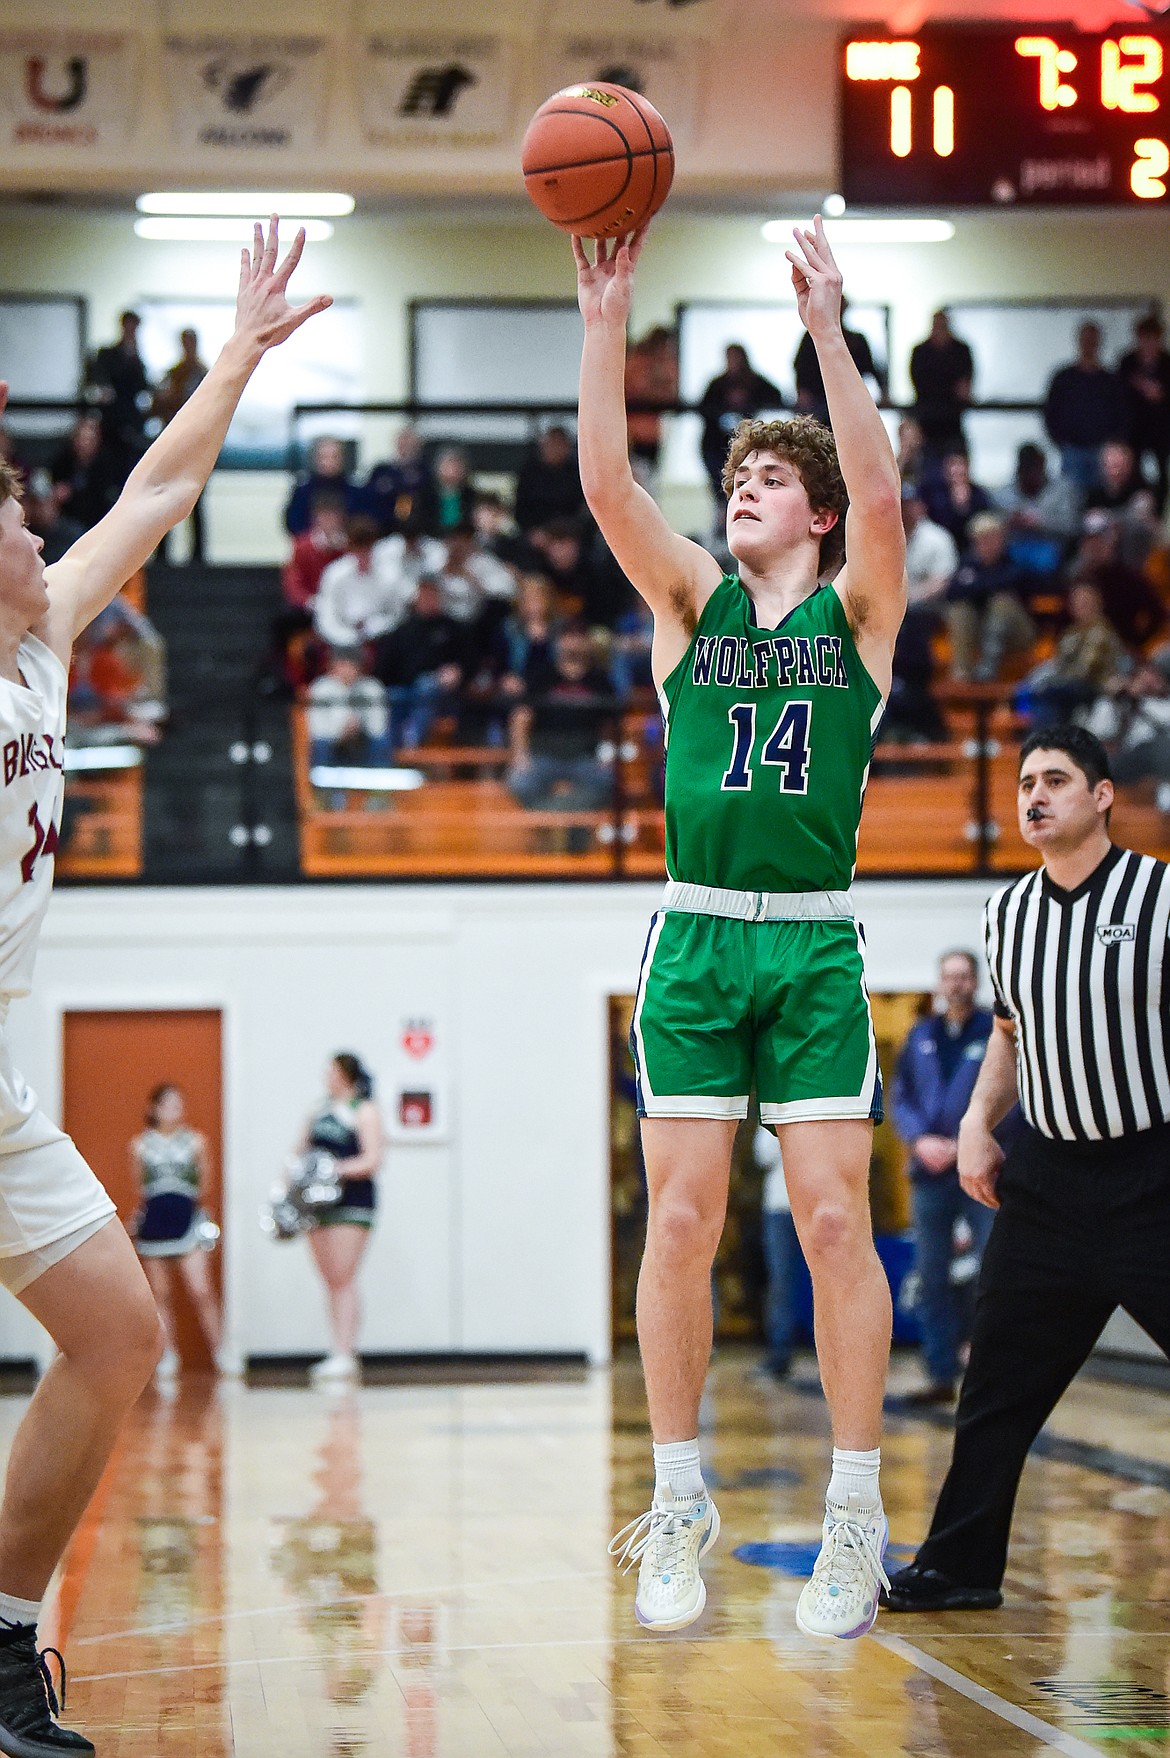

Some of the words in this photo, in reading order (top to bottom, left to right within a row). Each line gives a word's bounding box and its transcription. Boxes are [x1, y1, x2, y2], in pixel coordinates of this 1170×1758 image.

[1014, 36, 1163, 112] 7:12
[890, 85, 954, 158] 11
[1130, 138, 1170, 198] 2
[692, 635, 849, 689] WOLFPACK
[720, 700, 813, 795] 14
[1103, 928, 1132, 939] MOA
